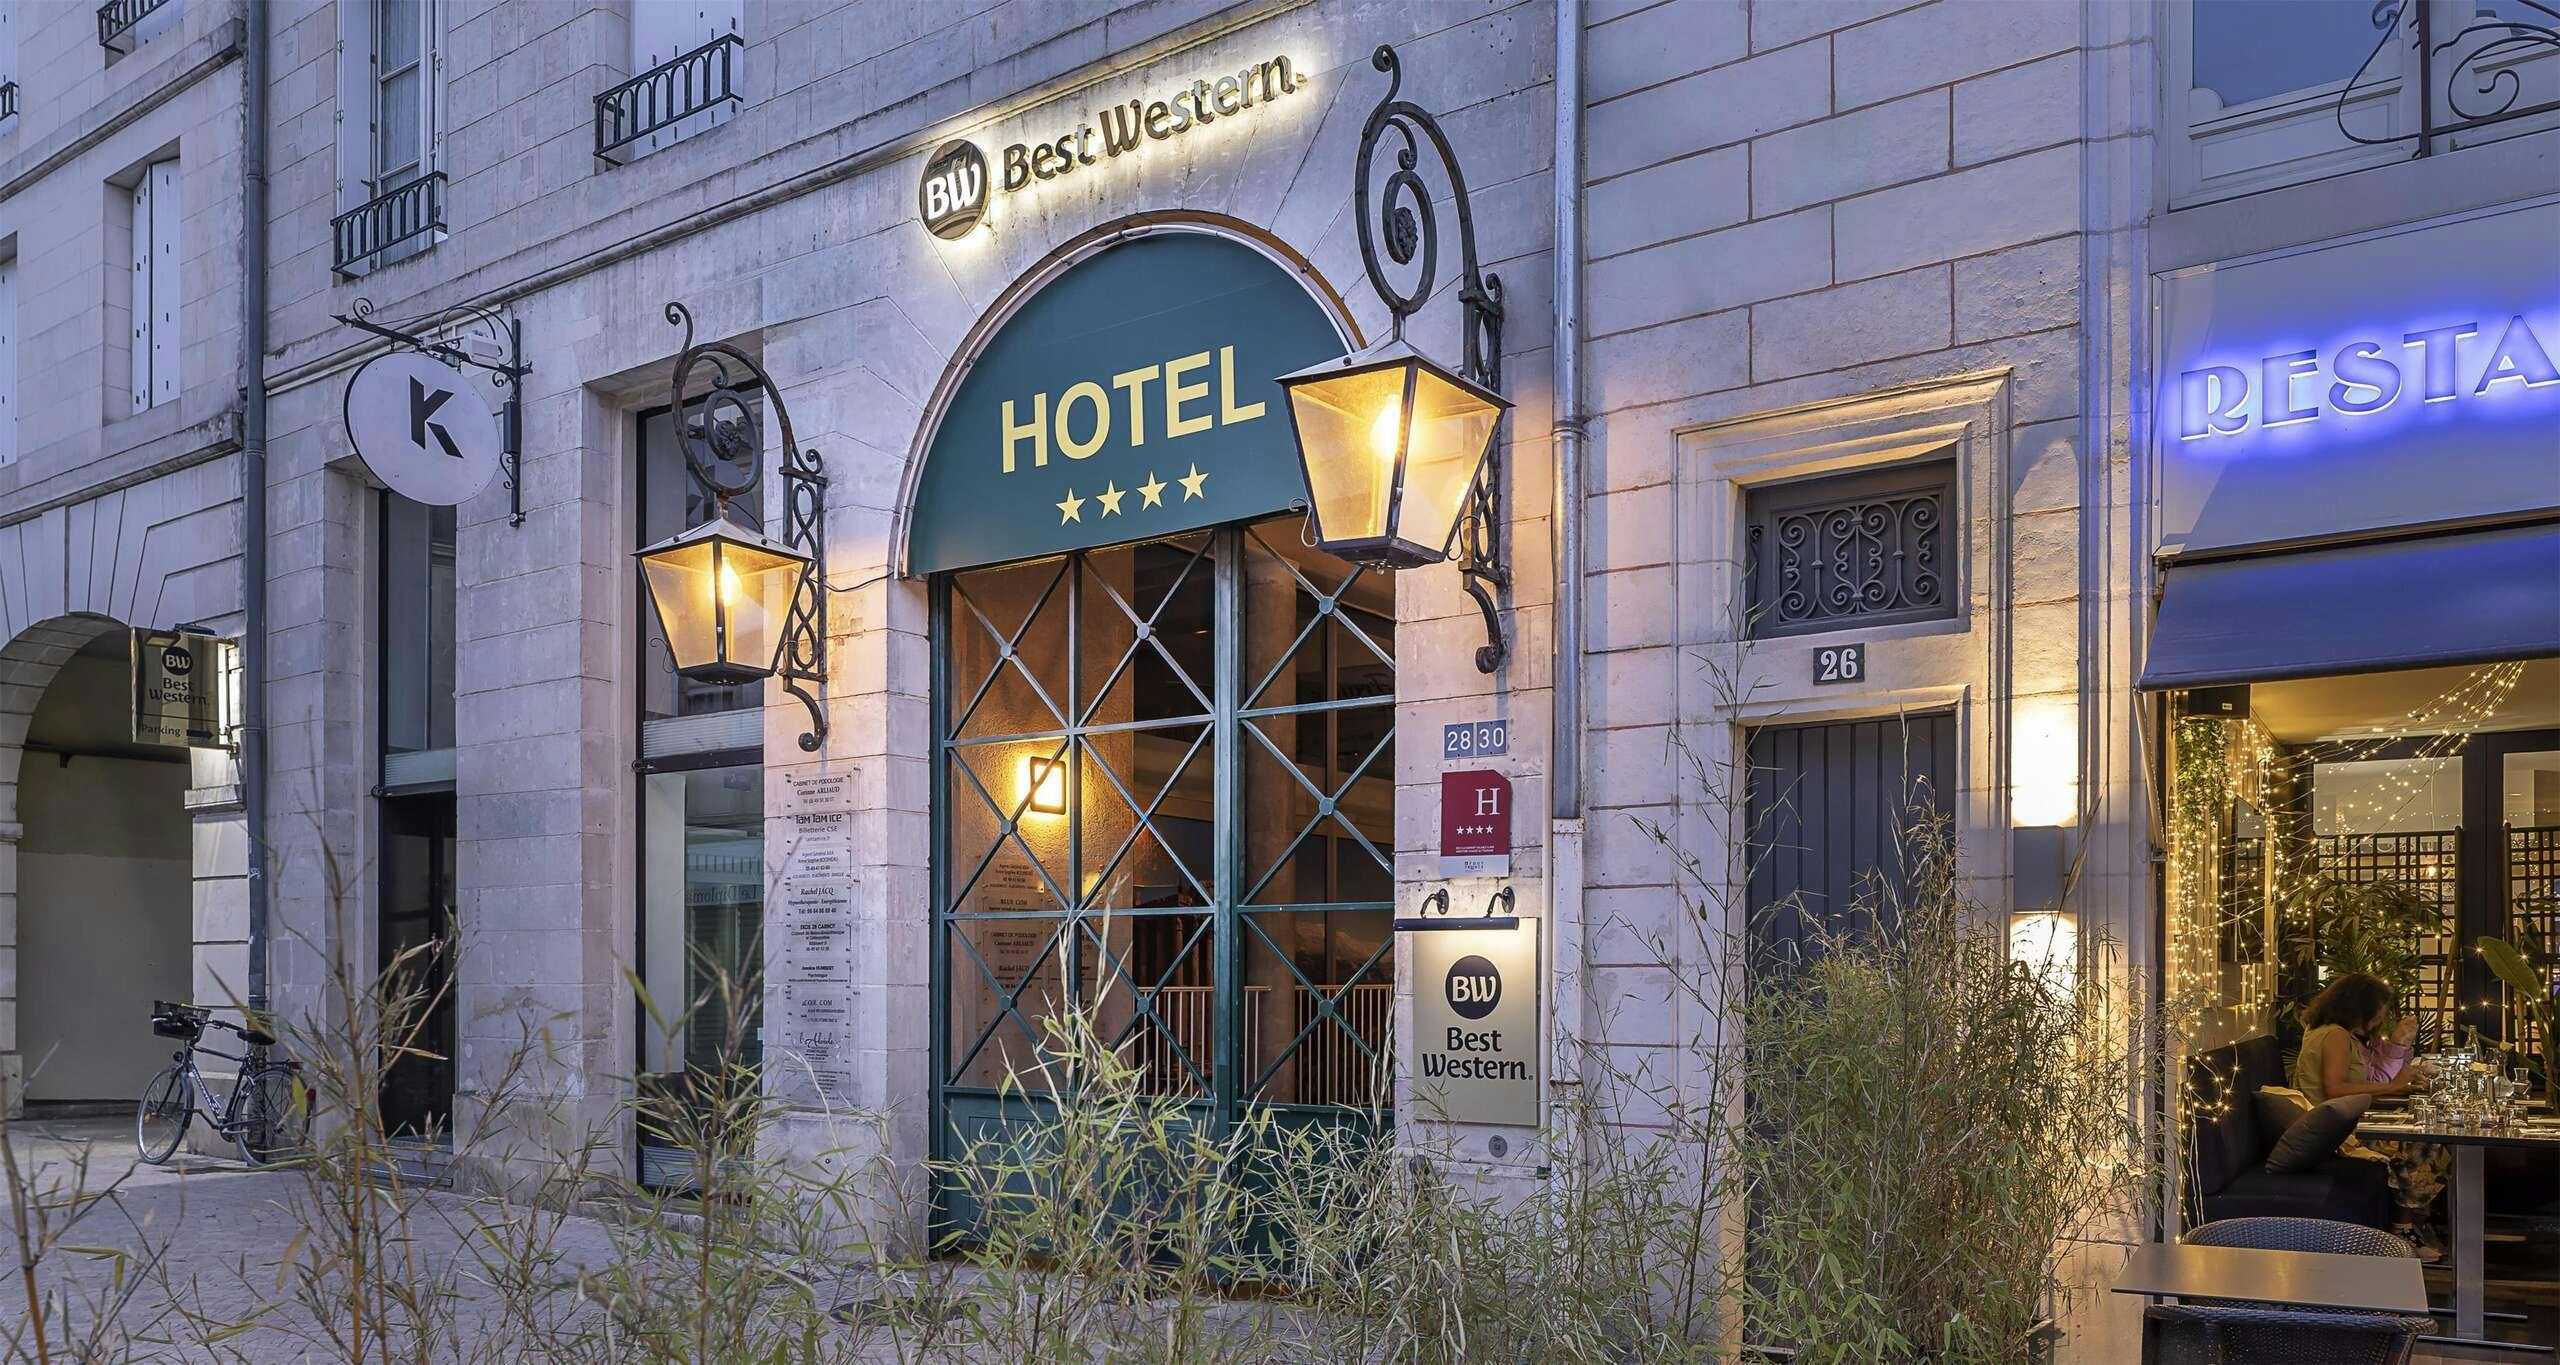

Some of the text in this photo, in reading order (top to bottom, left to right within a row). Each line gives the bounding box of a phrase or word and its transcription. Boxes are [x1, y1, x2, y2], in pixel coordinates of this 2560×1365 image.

[926, 54, 1296, 221] BW Best Western
[409, 374, 464, 459] K
[1001, 345, 1266, 473] HOTEL
[166, 654, 191, 669] BW
[1820, 648, 1858, 681] 26
[149, 688, 207, 705] Western
[163, 678, 193, 692] Best
[142, 724, 181, 737] Parking
[1447, 727, 1504, 751] 28 30
[1474, 787, 1501, 816] H
[1451, 975, 1497, 1003] BW
[1446, 1027, 1503, 1052] Best
[1421, 1053, 1528, 1081] Western
